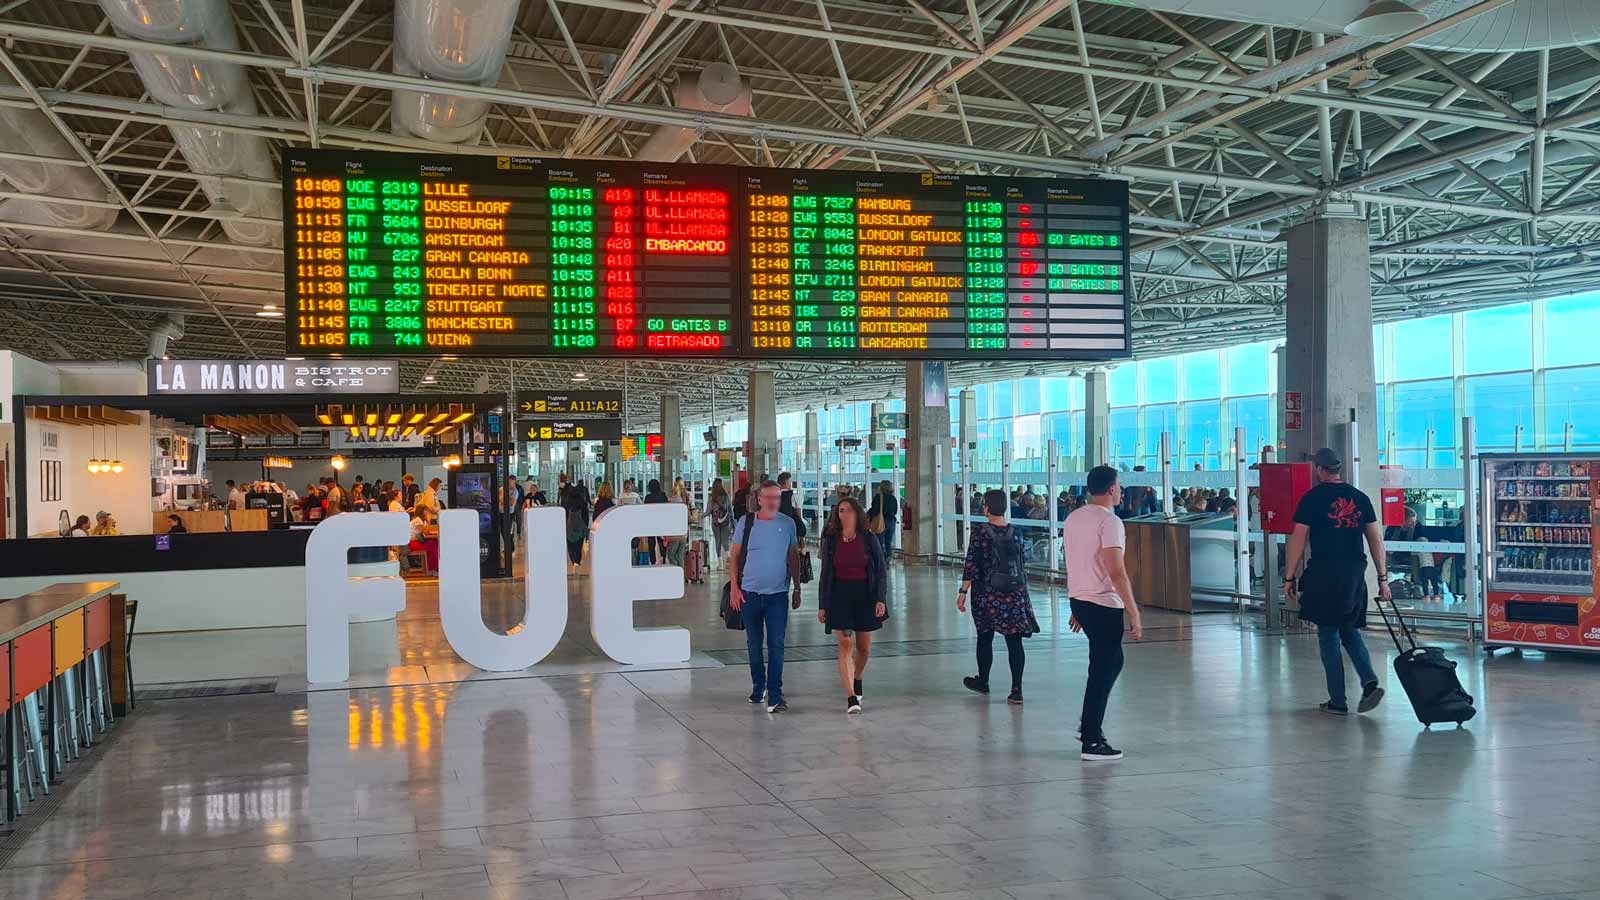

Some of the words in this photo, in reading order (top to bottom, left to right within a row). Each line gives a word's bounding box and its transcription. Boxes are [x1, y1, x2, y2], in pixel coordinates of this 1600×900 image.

[296, 179, 340, 191] 10:00
[347, 181, 374, 193] VOE
[383, 182, 418, 194] 2319
[425, 184, 467, 196] LILLE
[550, 188, 591, 199] 09:15
[646, 192, 726, 203] UL.LLAMADA
[297, 197, 341, 208] 10:50
[347, 198, 375, 210] EWG
[383, 199, 418, 211] 9547
[425, 200, 509, 213] DUSSELDORF
[552, 204, 592, 215] 10:10
[646, 208, 726, 219] UL.LLAMADA
[751, 195, 787, 206] 12:00
[794, 196, 816, 207] EWG
[824, 197, 853, 208] 7527
[859, 199, 910, 210] HAMBURG
[968, 203, 1001, 213] 11:30
[297, 214, 341, 225] 11:15
[348, 215, 366, 226] FR
[383, 216, 418, 227] 5684
[425, 217, 502, 229] EDINBURGH
[552, 221, 592, 232] 10:35
[647, 224, 726, 235] UL.LLAMADA
[752, 211, 787, 222] 12:20
[794, 212, 816, 223] EWG
[824, 213, 853, 223] 9553
[860, 215, 931, 225] DUSSELDORF
[968, 218, 1002, 228] 11:50
[298, 231, 341, 242] 11:20
[384, 233, 419, 244] 6706
[426, 234, 502, 246] AMSTERDAM
[553, 237, 592, 248] 10:38
[647, 240, 726, 251] EMBARCANDO
[752, 227, 788, 237] 12:15
[794, 228, 816, 238] EZY
[824, 228, 853, 239] 8042
[859, 230, 903, 240] LONDON
[911, 231, 960, 241] GATWICK
[968, 233, 1002, 243] 11:50
[298, 248, 341, 259] 11:05
[349, 248, 366, 260] NT
[393, 250, 419, 261] 227
[426, 251, 460, 261] GRAN
[469, 252, 528, 263] CANARIA
[553, 254, 592, 264] 10:48
[752, 243, 788, 253] 12:35
[795, 243, 809, 254] DE
[826, 244, 854, 254] 1403
[860, 245, 924, 256] FRANKFURT
[969, 248, 1002, 258] 12:10
[299, 265, 342, 276] 11:20
[349, 265, 376, 277] EWG
[393, 266, 420, 278] 243
[426, 267, 469, 278] KOELN
[478, 268, 511, 279] BONN
[553, 270, 592, 281] 10:55
[752, 258, 788, 269] 12:40
[795, 259, 810, 269] FR
[825, 259, 854, 270] 3246
[969, 263, 1003, 273] 12:10
[753, 274, 789, 284] 12:45
[795, 274, 818, 284] EFW
[825, 275, 853, 285] 2711
[861, 276, 904, 286] LONDON
[912, 277, 961, 287] GATWICK
[969, 278, 1003, 288] 12:20
[299, 282, 343, 293] 11:30
[349, 283, 367, 294] NT
[394, 283, 419, 295] 953
[427, 284, 494, 295] TENERIFE
[504, 285, 544, 296] NORTE
[554, 287, 593, 297] 11:10
[753, 290, 789, 300] 12:45
[796, 290, 809, 300] NT
[833, 291, 855, 301] 229
[861, 291, 890, 301] GRAN
[897, 292, 948, 302] CANARIA
[968, 293, 1004, 303] 12:25
[300, 299, 343, 310] 11:40
[350, 299, 377, 311] EWG
[385, 300, 420, 311] 2247
[427, 301, 502, 312] STUTTGART
[554, 303, 593, 313] 11:15
[753, 306, 789, 316] 12:45
[797, 306, 818, 316] IBE
[841, 306, 855, 316] 89
[861, 307, 890, 317] GRAN
[898, 307, 948, 317] CANARIA
[968, 308, 1004, 318] 12:25
[300, 316, 343, 327] 11:45
[350, 316, 368, 327] FR
[386, 317, 420, 328] 3806
[427, 318, 512, 328] MANCHESTER
[554, 319, 593, 330] 11:15
[648, 320, 663, 330] GO
[672, 320, 710, 330] GATES
[719, 320, 726, 330] B
[754, 321, 790, 331] 13:10
[796, 321, 811, 331] OR
[828, 322, 853, 332] 1611
[861, 322, 927, 332] ROTTERDAM
[970, 323, 1004, 333] 12:40
[300, 333, 343, 344] 11:05
[350, 333, 368, 344] FR
[395, 333, 421, 344] 744
[428, 334, 470, 345] VIENA
[555, 335, 594, 346] 11:20
[649, 336, 719, 346] RETRASADO
[754, 337, 790, 347] 13:10
[797, 337, 811, 347] OR
[828, 337, 854, 347] 1611
[862, 338, 927, 348] LANZAROTE
[971, 338, 1004, 348] 12:40
[156, 365, 186, 390] LA
[201, 364, 284, 390] MANON
[295, 367, 392, 375] BISTROT
[295, 378, 306, 386] &
[576, 428, 584, 437] B
[305, 503, 691, 683] FUE
